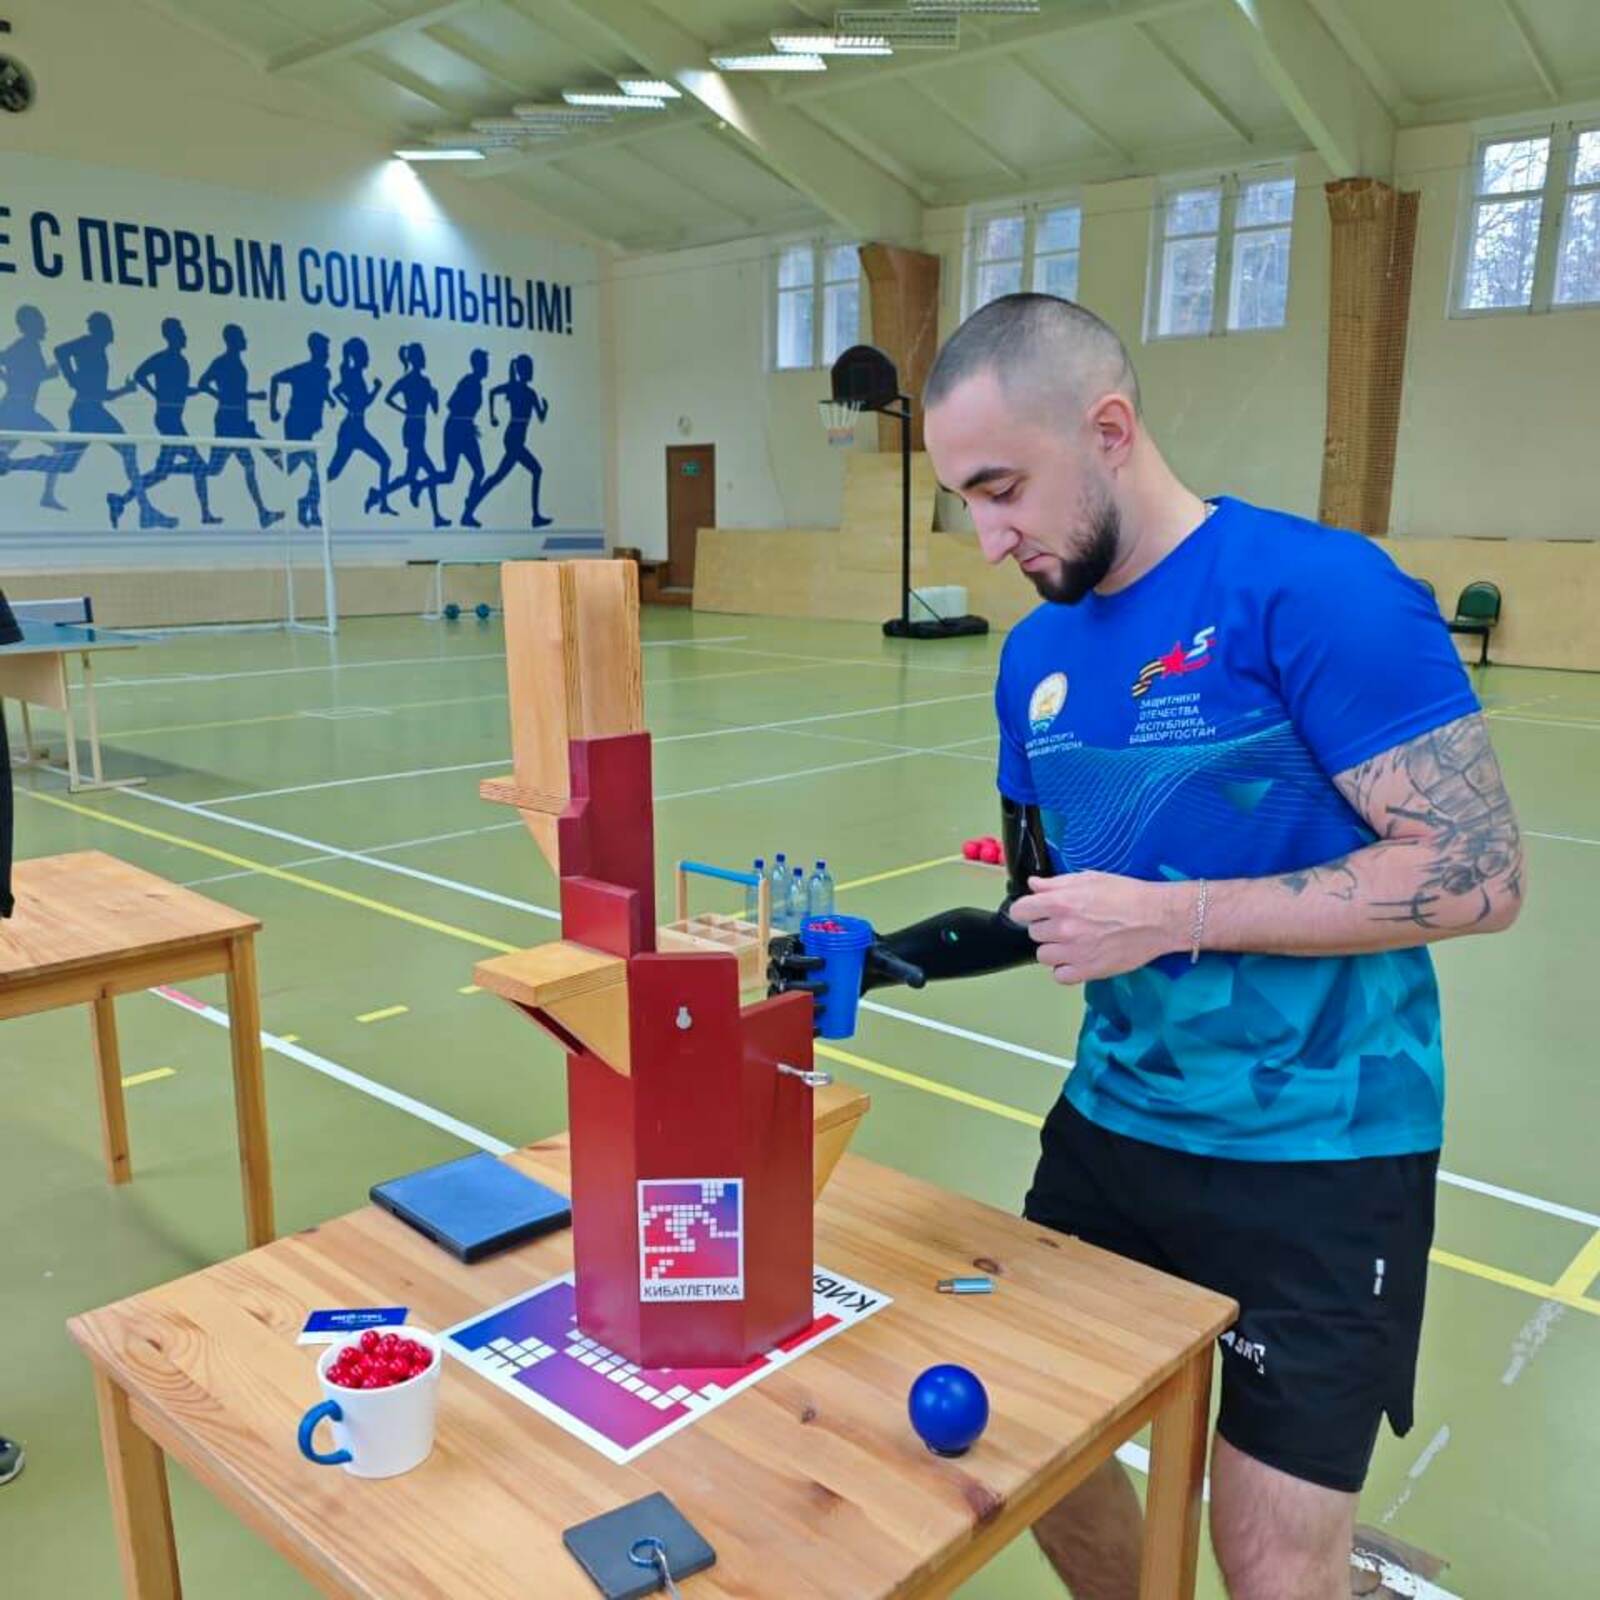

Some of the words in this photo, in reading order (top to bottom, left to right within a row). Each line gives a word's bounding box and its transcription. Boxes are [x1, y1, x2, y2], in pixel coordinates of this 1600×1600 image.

[30, 211, 63, 278] С
[77, 217, 286, 302] ПЕРВЫМ
[299, 246, 573, 335] СОЦИАЛЬНЫМ!
[643, 1283, 741, 1298] КИБАТЛЕТИКА
[813, 1273, 877, 1313] КИБ
